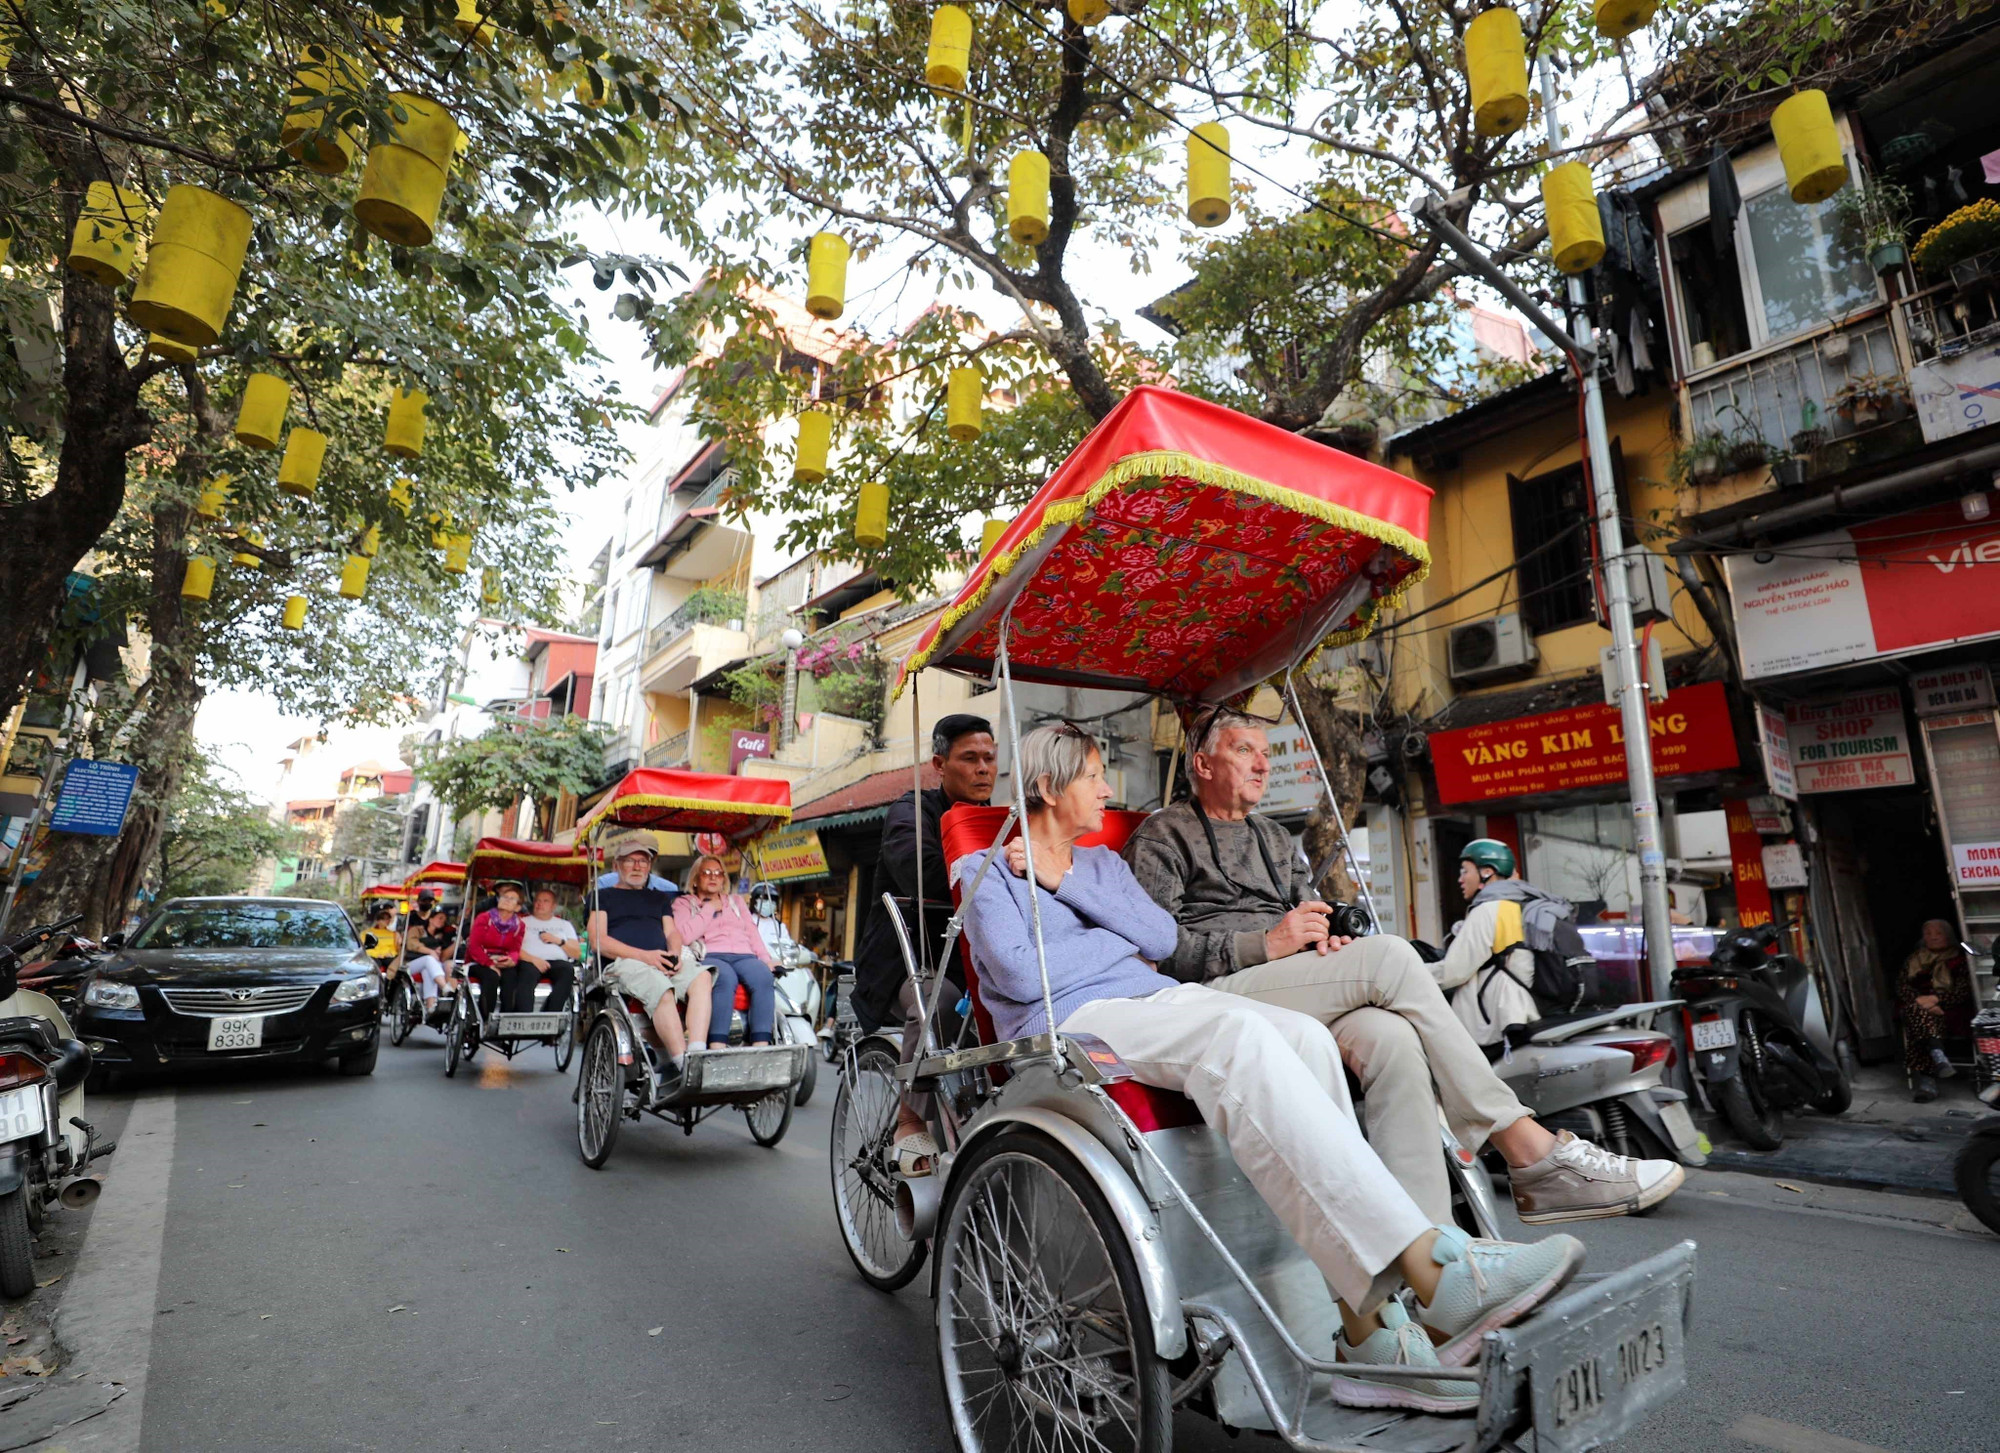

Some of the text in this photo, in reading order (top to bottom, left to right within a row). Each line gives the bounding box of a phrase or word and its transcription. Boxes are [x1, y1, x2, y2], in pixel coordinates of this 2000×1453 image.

[1468, 729, 1493, 739] CÔNG
[1499, 725, 1510, 734] TY
[1515, 721, 1540, 731] TNHH
[1816, 717, 1874, 741] SHOP
[737, 736, 765, 752] Café
[1462, 713, 1688, 766] VÀNG KIM LNG
[1800, 736, 1899, 761] FOR TOURISM
[1471, 773, 1492, 783] MUA
[1570, 756, 1598, 769] VÀNG
[1603, 754, 1625, 765] BẠC
[1661, 744, 1687, 756] 9999
[74, 767, 100, 776] ELECTRIC
[112, 772, 131, 780] ROUTE
[1737, 859, 1763, 882] BÁN
[222, 1019, 252, 1033] 99K
[1697, 1021, 1727, 1037] 29-C1
[215, 1033, 255, 1048] 8338
